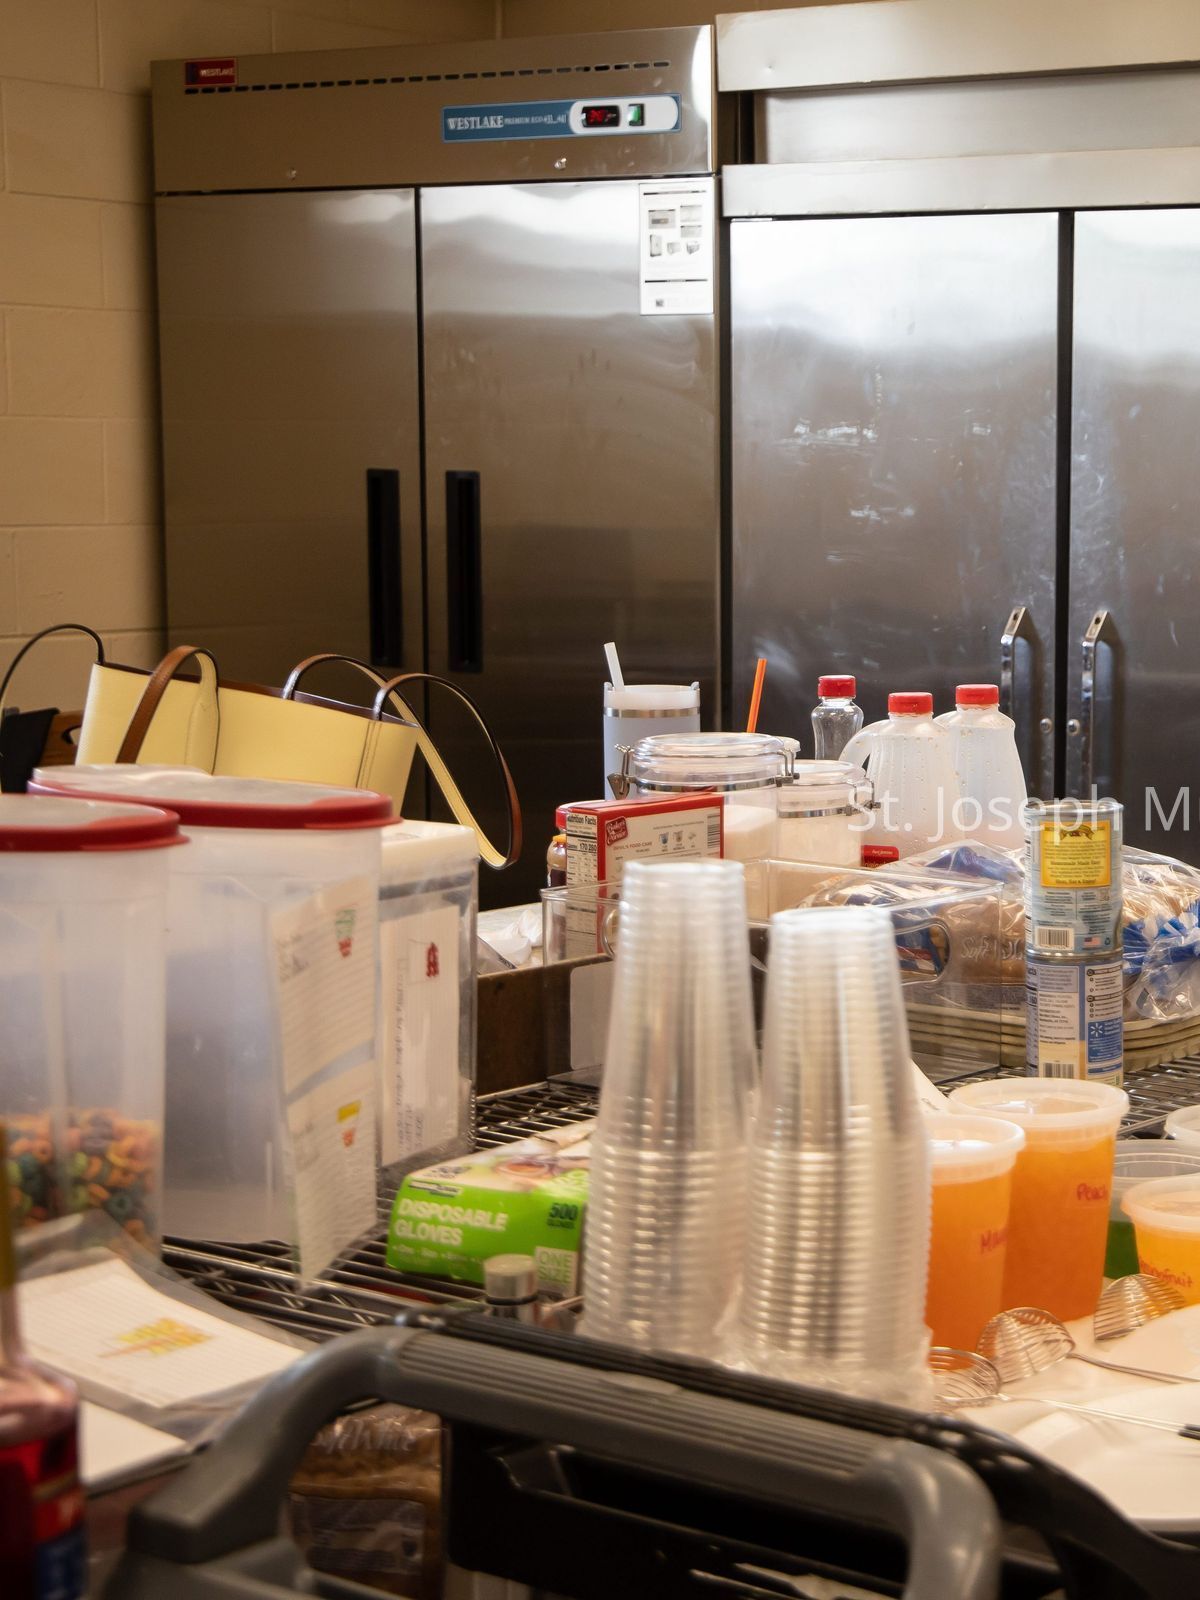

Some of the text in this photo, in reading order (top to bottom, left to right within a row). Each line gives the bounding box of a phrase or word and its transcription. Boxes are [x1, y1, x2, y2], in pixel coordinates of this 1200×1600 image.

[447, 115, 504, 130] WESTLAKE
[397, 1198, 509, 1232] DISPOSABLE
[394, 1219, 463, 1247] GLOVES
